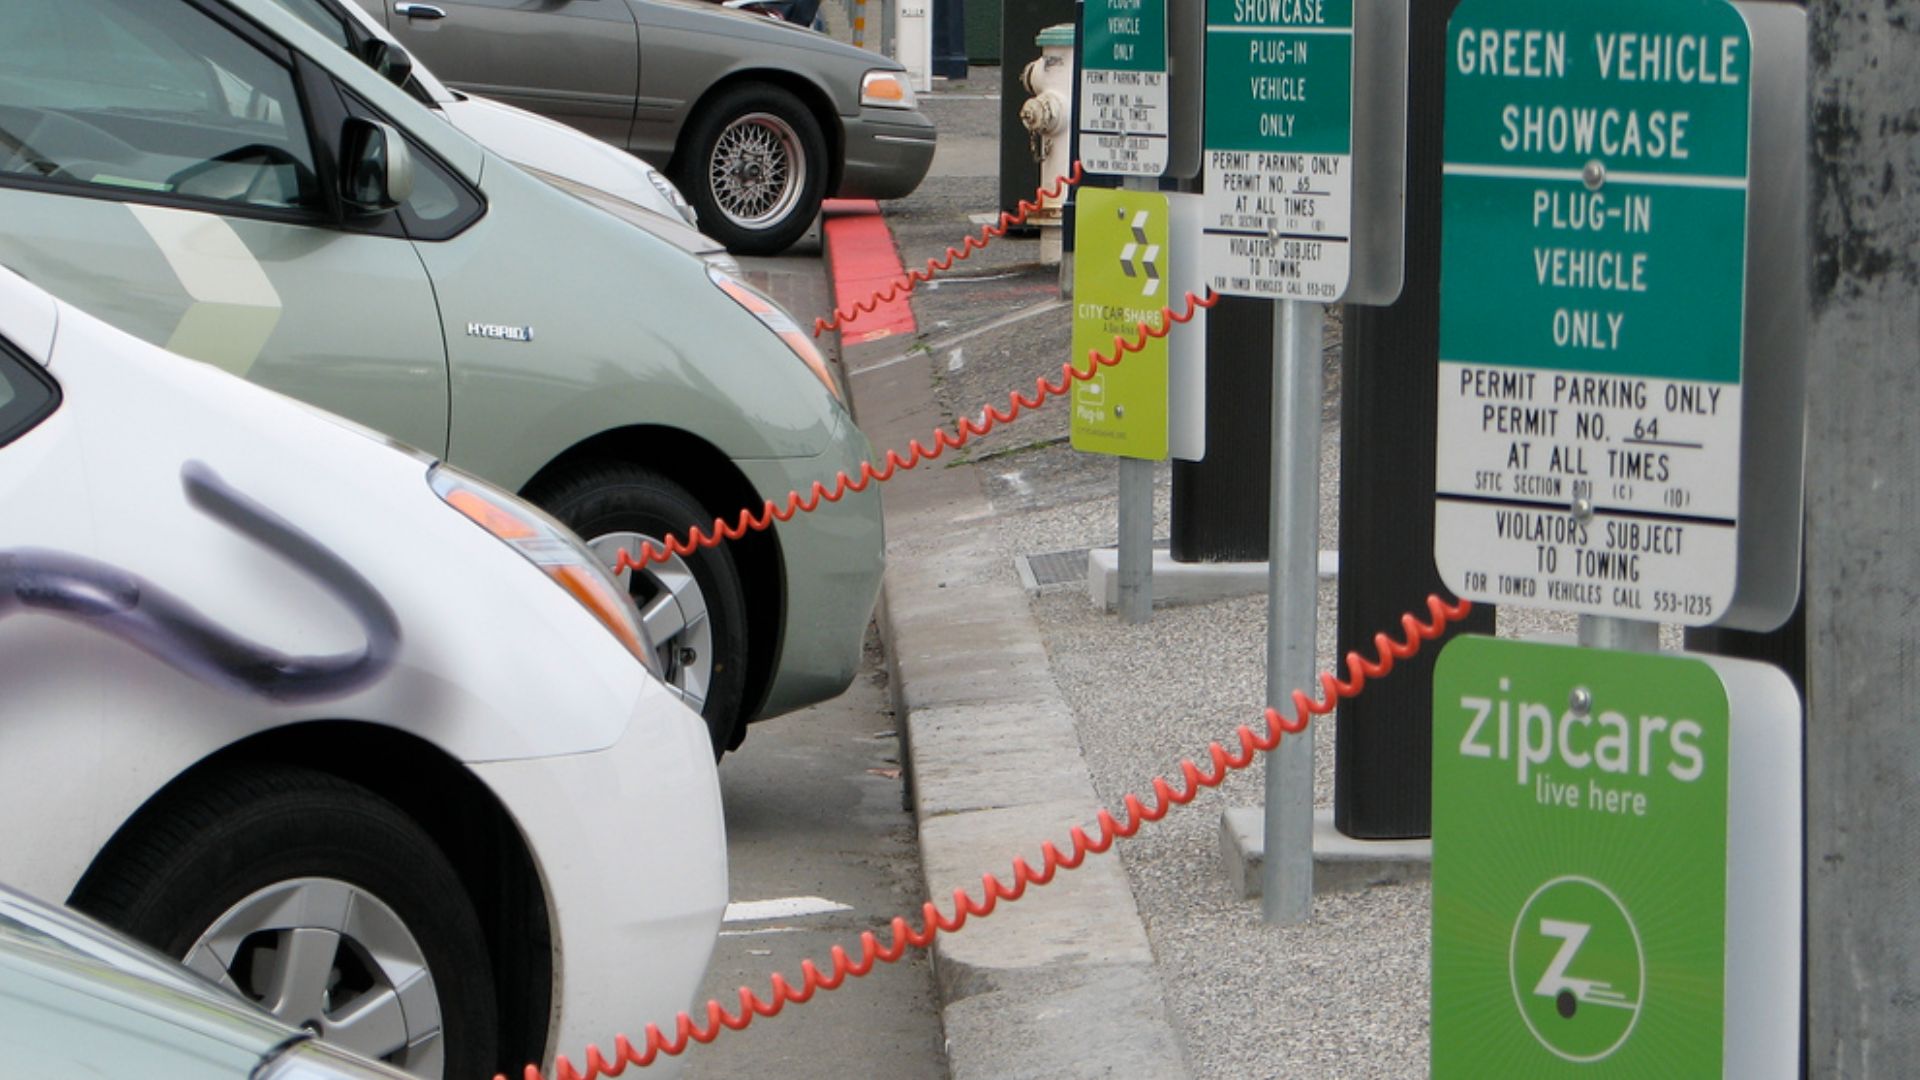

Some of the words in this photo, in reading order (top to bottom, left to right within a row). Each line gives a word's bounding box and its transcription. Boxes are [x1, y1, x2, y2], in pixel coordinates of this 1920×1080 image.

[1108, 17, 1140, 35] VEHICLE
[1234, 0, 1324, 23] SHOWCASE
[1113, 44, 1134, 61] ONLY
[1250, 40, 1307, 64] PLUG-IN
[1457, 28, 1566, 77] GREEN
[1596, 33, 1740, 84] VEHICLE
[1251, 77, 1306, 101] VEHICLE
[1260, 113, 1295, 137] ONLY
[1500, 105, 1689, 159] SHOWCASE
[1213, 153, 1250, 170] PERMIT
[1258, 155, 1304, 174] PARKING
[1312, 157, 1339, 175] ONLY
[1224, 174, 1261, 192] PERMIT
[1269, 176, 1287, 193] NO.
[1298, 177, 1310, 191] 65
[1235, 196, 1247, 212] AT
[1256, 197, 1275, 215] ALL
[1285, 198, 1315, 216] TIMES
[1533, 190, 1651, 233] PLUG-IN
[1230, 238, 1276, 257] VIOLATORS
[1284, 242, 1322, 261] SUBJECT
[1250, 259, 1260, 275] TO
[1269, 260, 1301, 278] TOWING
[1534, 247, 1647, 291] VEHICLE
[466, 322, 528, 341] HYBRID
[1553, 308, 1623, 349] ONLY
[1460, 369, 1536, 400] PERMIT
[1554, 376, 1647, 410] PARKING
[1665, 384, 1721, 415] ONLY
[1482, 405, 1558, 437] PERMIT
[1577, 412, 1610, 442] NO.
[1633, 418, 1659, 439] 64
[1507, 443, 1531, 469] AT
[1550, 447, 1588, 475] ALL
[1607, 450, 1669, 482] TIMES
[1475, 471, 1502, 492] SFTC
[1514, 475, 1561, 497] SECTION
[1612, 484, 1633, 500] (C)
[1664, 488, 1690, 507] (10)
[1496, 511, 1588, 545] VIOLATORS
[1606, 521, 1683, 555] SUBJECT
[1537, 546, 1556, 573] TO
[1575, 551, 1640, 582] TOWING
[1465, 572, 1487, 593] FOR
[1498, 575, 1536, 597] TOWED
[1549, 582, 1601, 604] VEHICLES
[1613, 587, 1642, 610] CALL
[1654, 592, 1712, 617] 553-1235
[1459, 677, 1704, 785] zipcars
[1536, 774, 1580, 807] live
[1589, 780, 1647, 816] here
